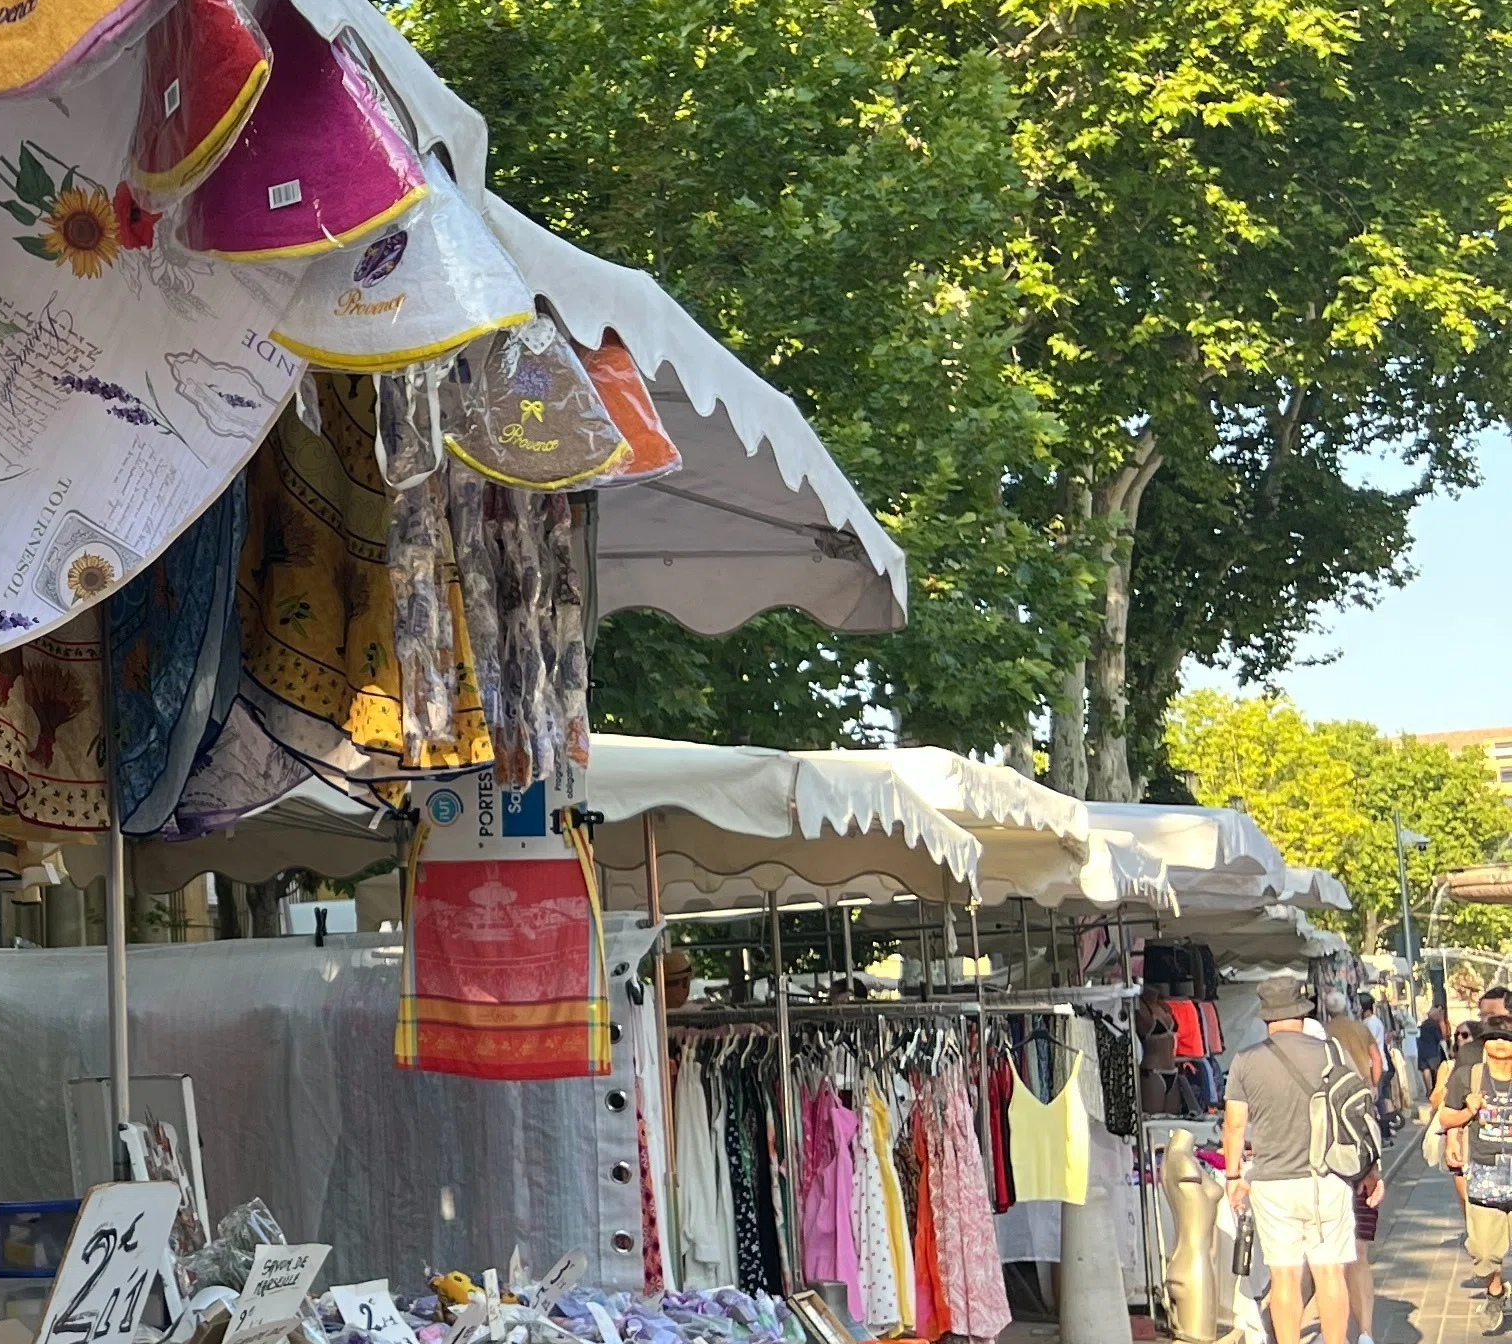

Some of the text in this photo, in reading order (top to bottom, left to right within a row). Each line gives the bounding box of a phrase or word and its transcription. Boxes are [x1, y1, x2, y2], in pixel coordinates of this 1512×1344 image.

[498, 423, 560, 452] Provence
[4, 476, 73, 600] TOURNESOL
[478, 772, 494, 837] PORTES
